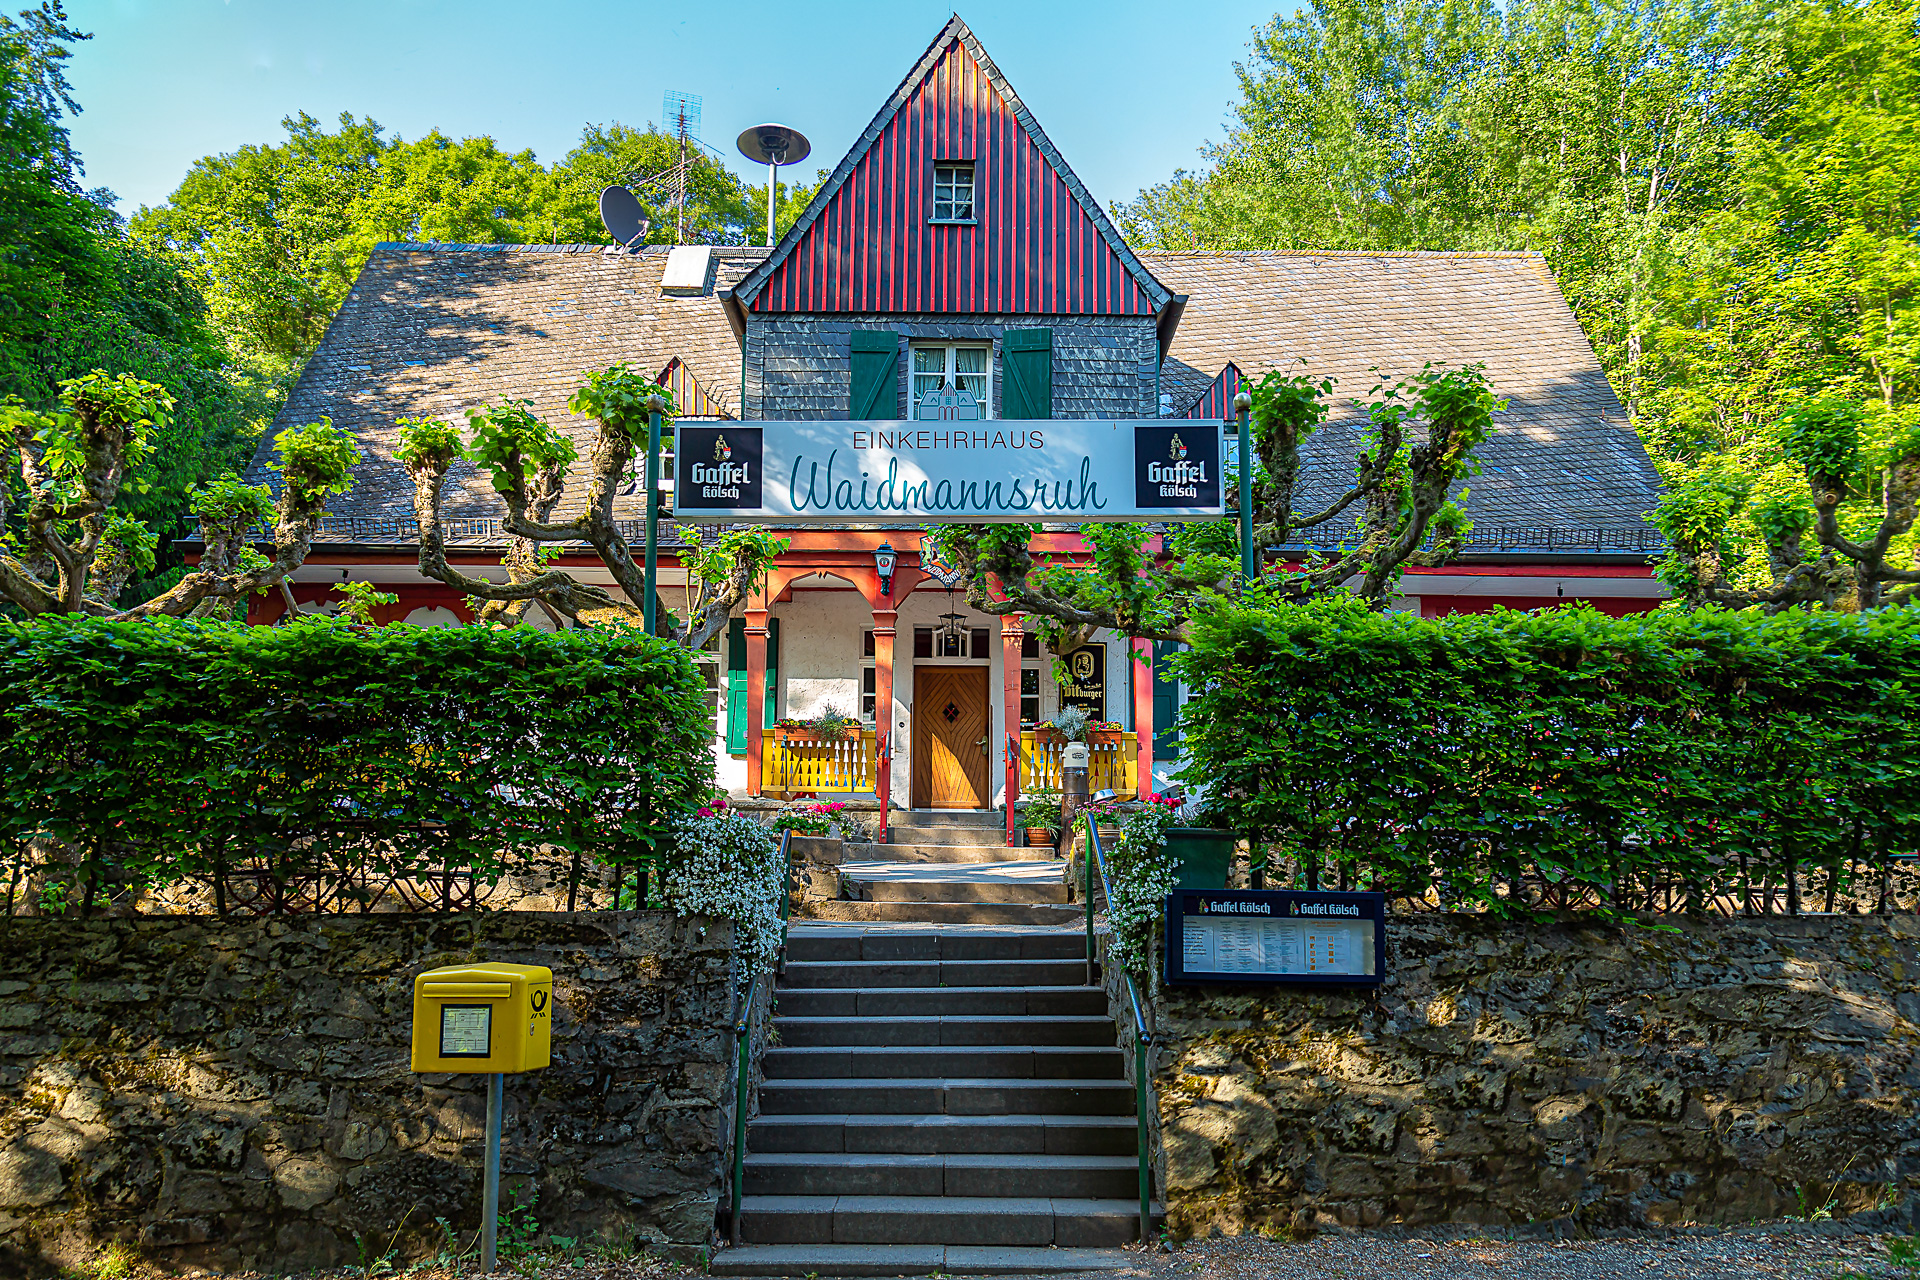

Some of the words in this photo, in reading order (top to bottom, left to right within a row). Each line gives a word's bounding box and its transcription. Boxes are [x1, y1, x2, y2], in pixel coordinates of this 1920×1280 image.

[853, 431, 1044, 449] EINKEHRHAUS
[691, 461, 751, 486] Gaffel
[789, 448, 1108, 511] Waidmannsruh
[1148, 460, 1208, 485] Gaffel
[1210, 901, 1238, 914] Gaffel
[1301, 903, 1328, 916] Gaffel
